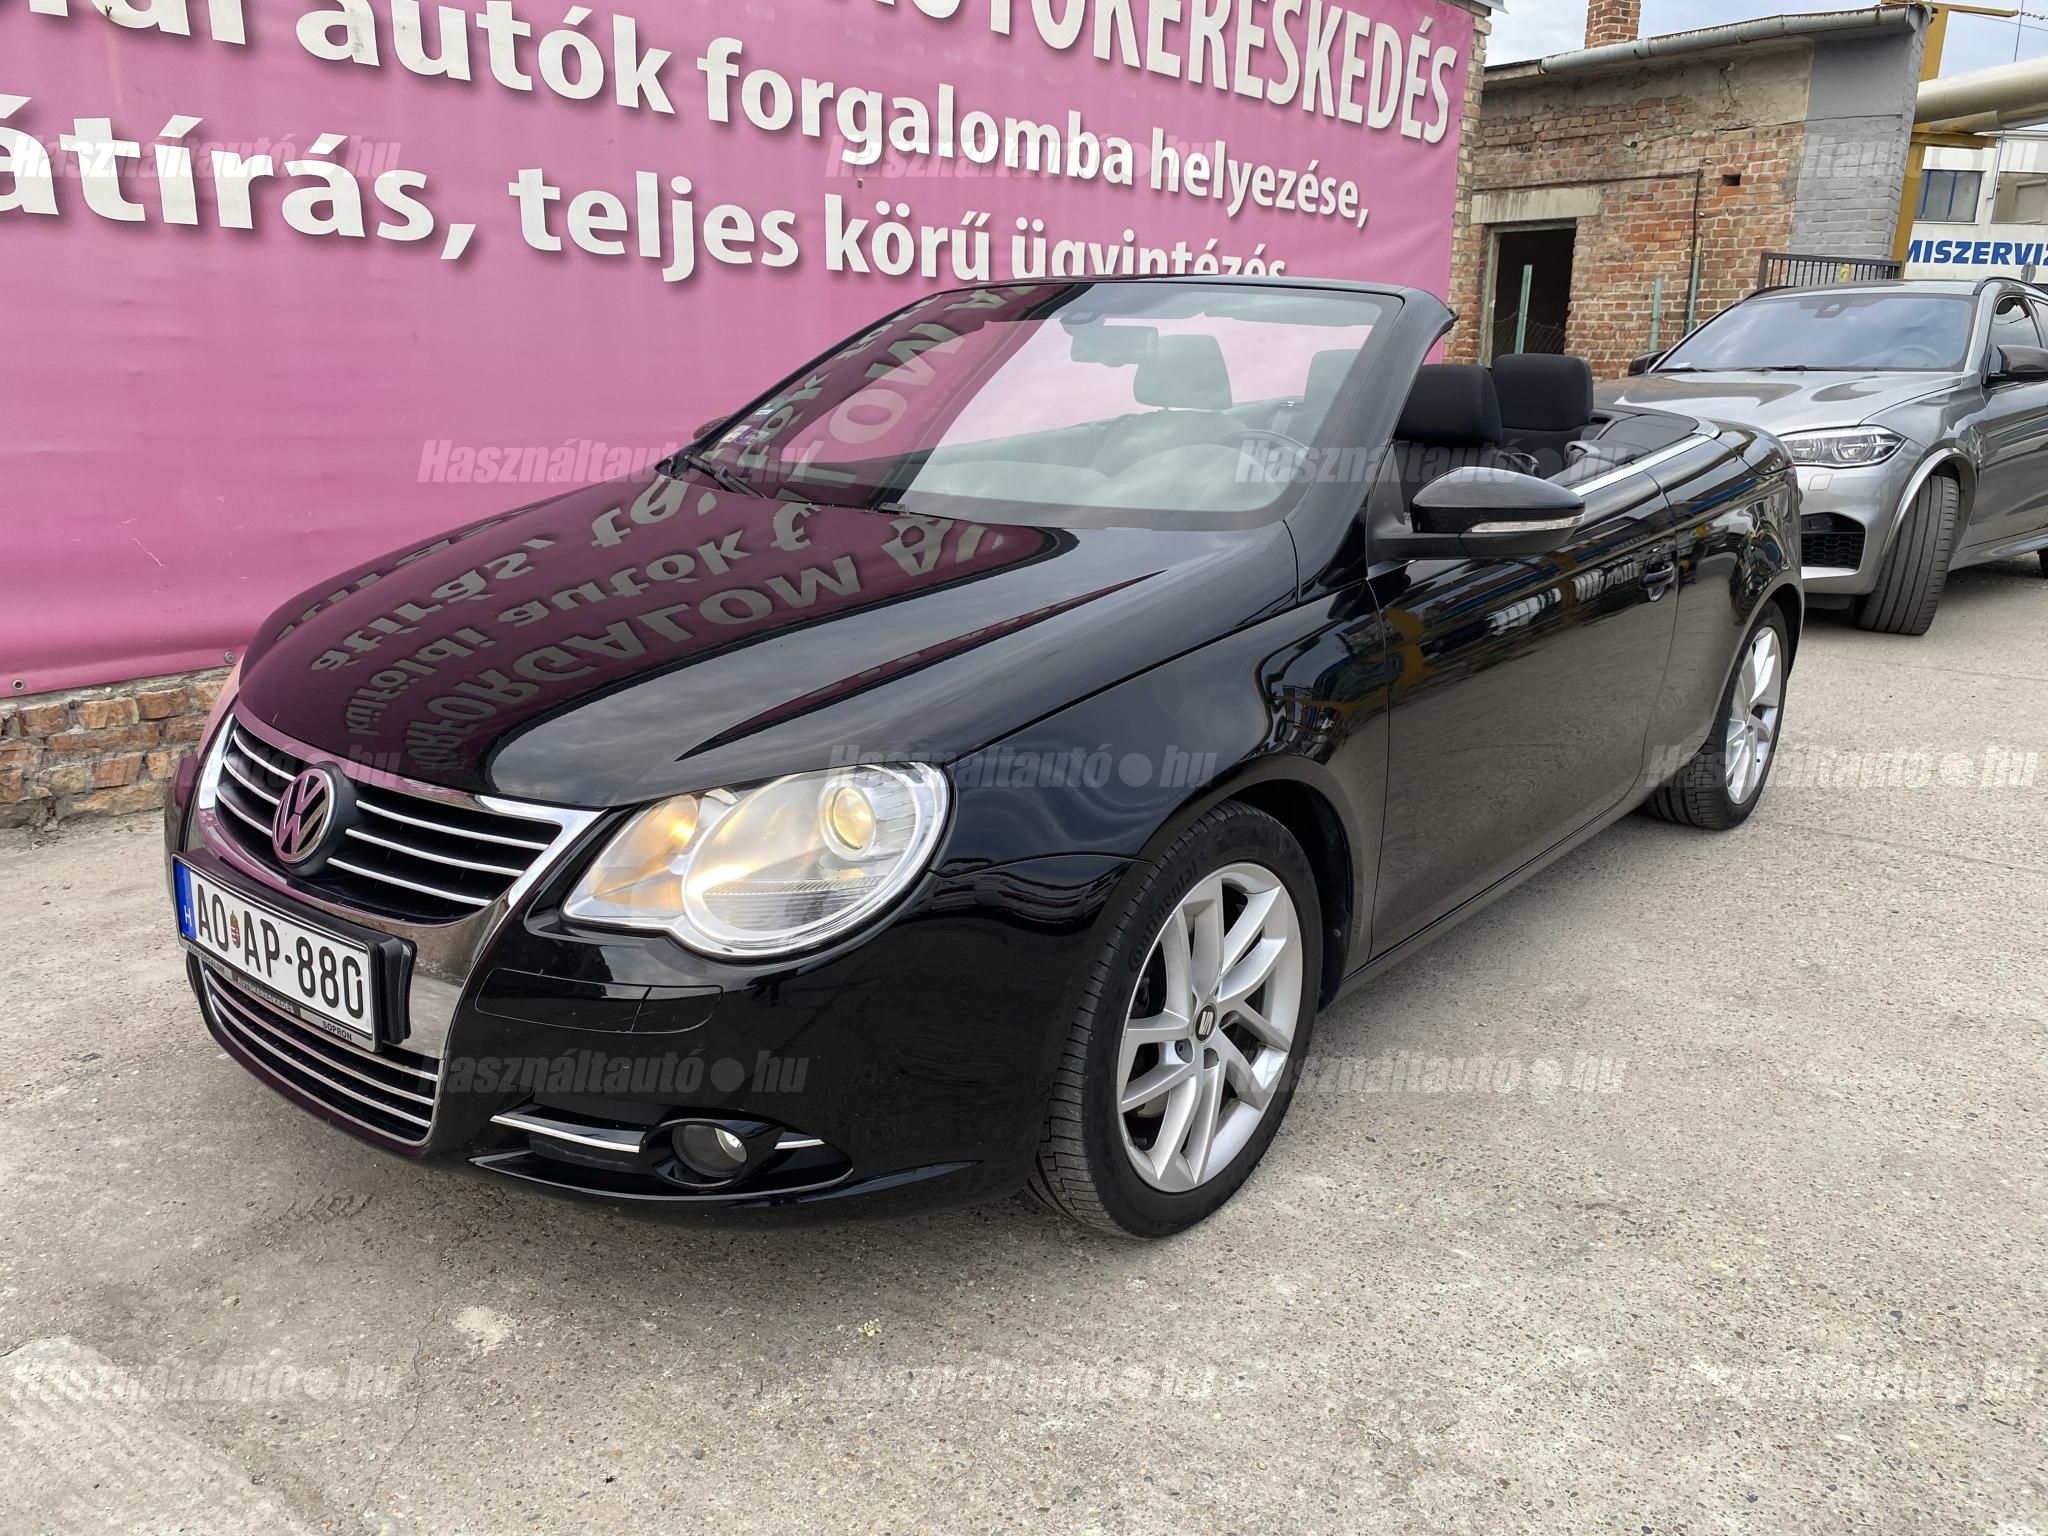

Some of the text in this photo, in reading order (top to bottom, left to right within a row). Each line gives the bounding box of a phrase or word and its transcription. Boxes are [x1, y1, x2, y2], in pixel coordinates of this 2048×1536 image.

[296, 0, 1369, 228] autók forgalomba helyezése,
[0, 94, 477, 260] átírás,
[509, 168, 799, 282] teljes
[824, 194, 991, 281] körű
[1906, 240, 2048, 265] MISZERVI
[321, 1020, 353, 1041] SOPRON
